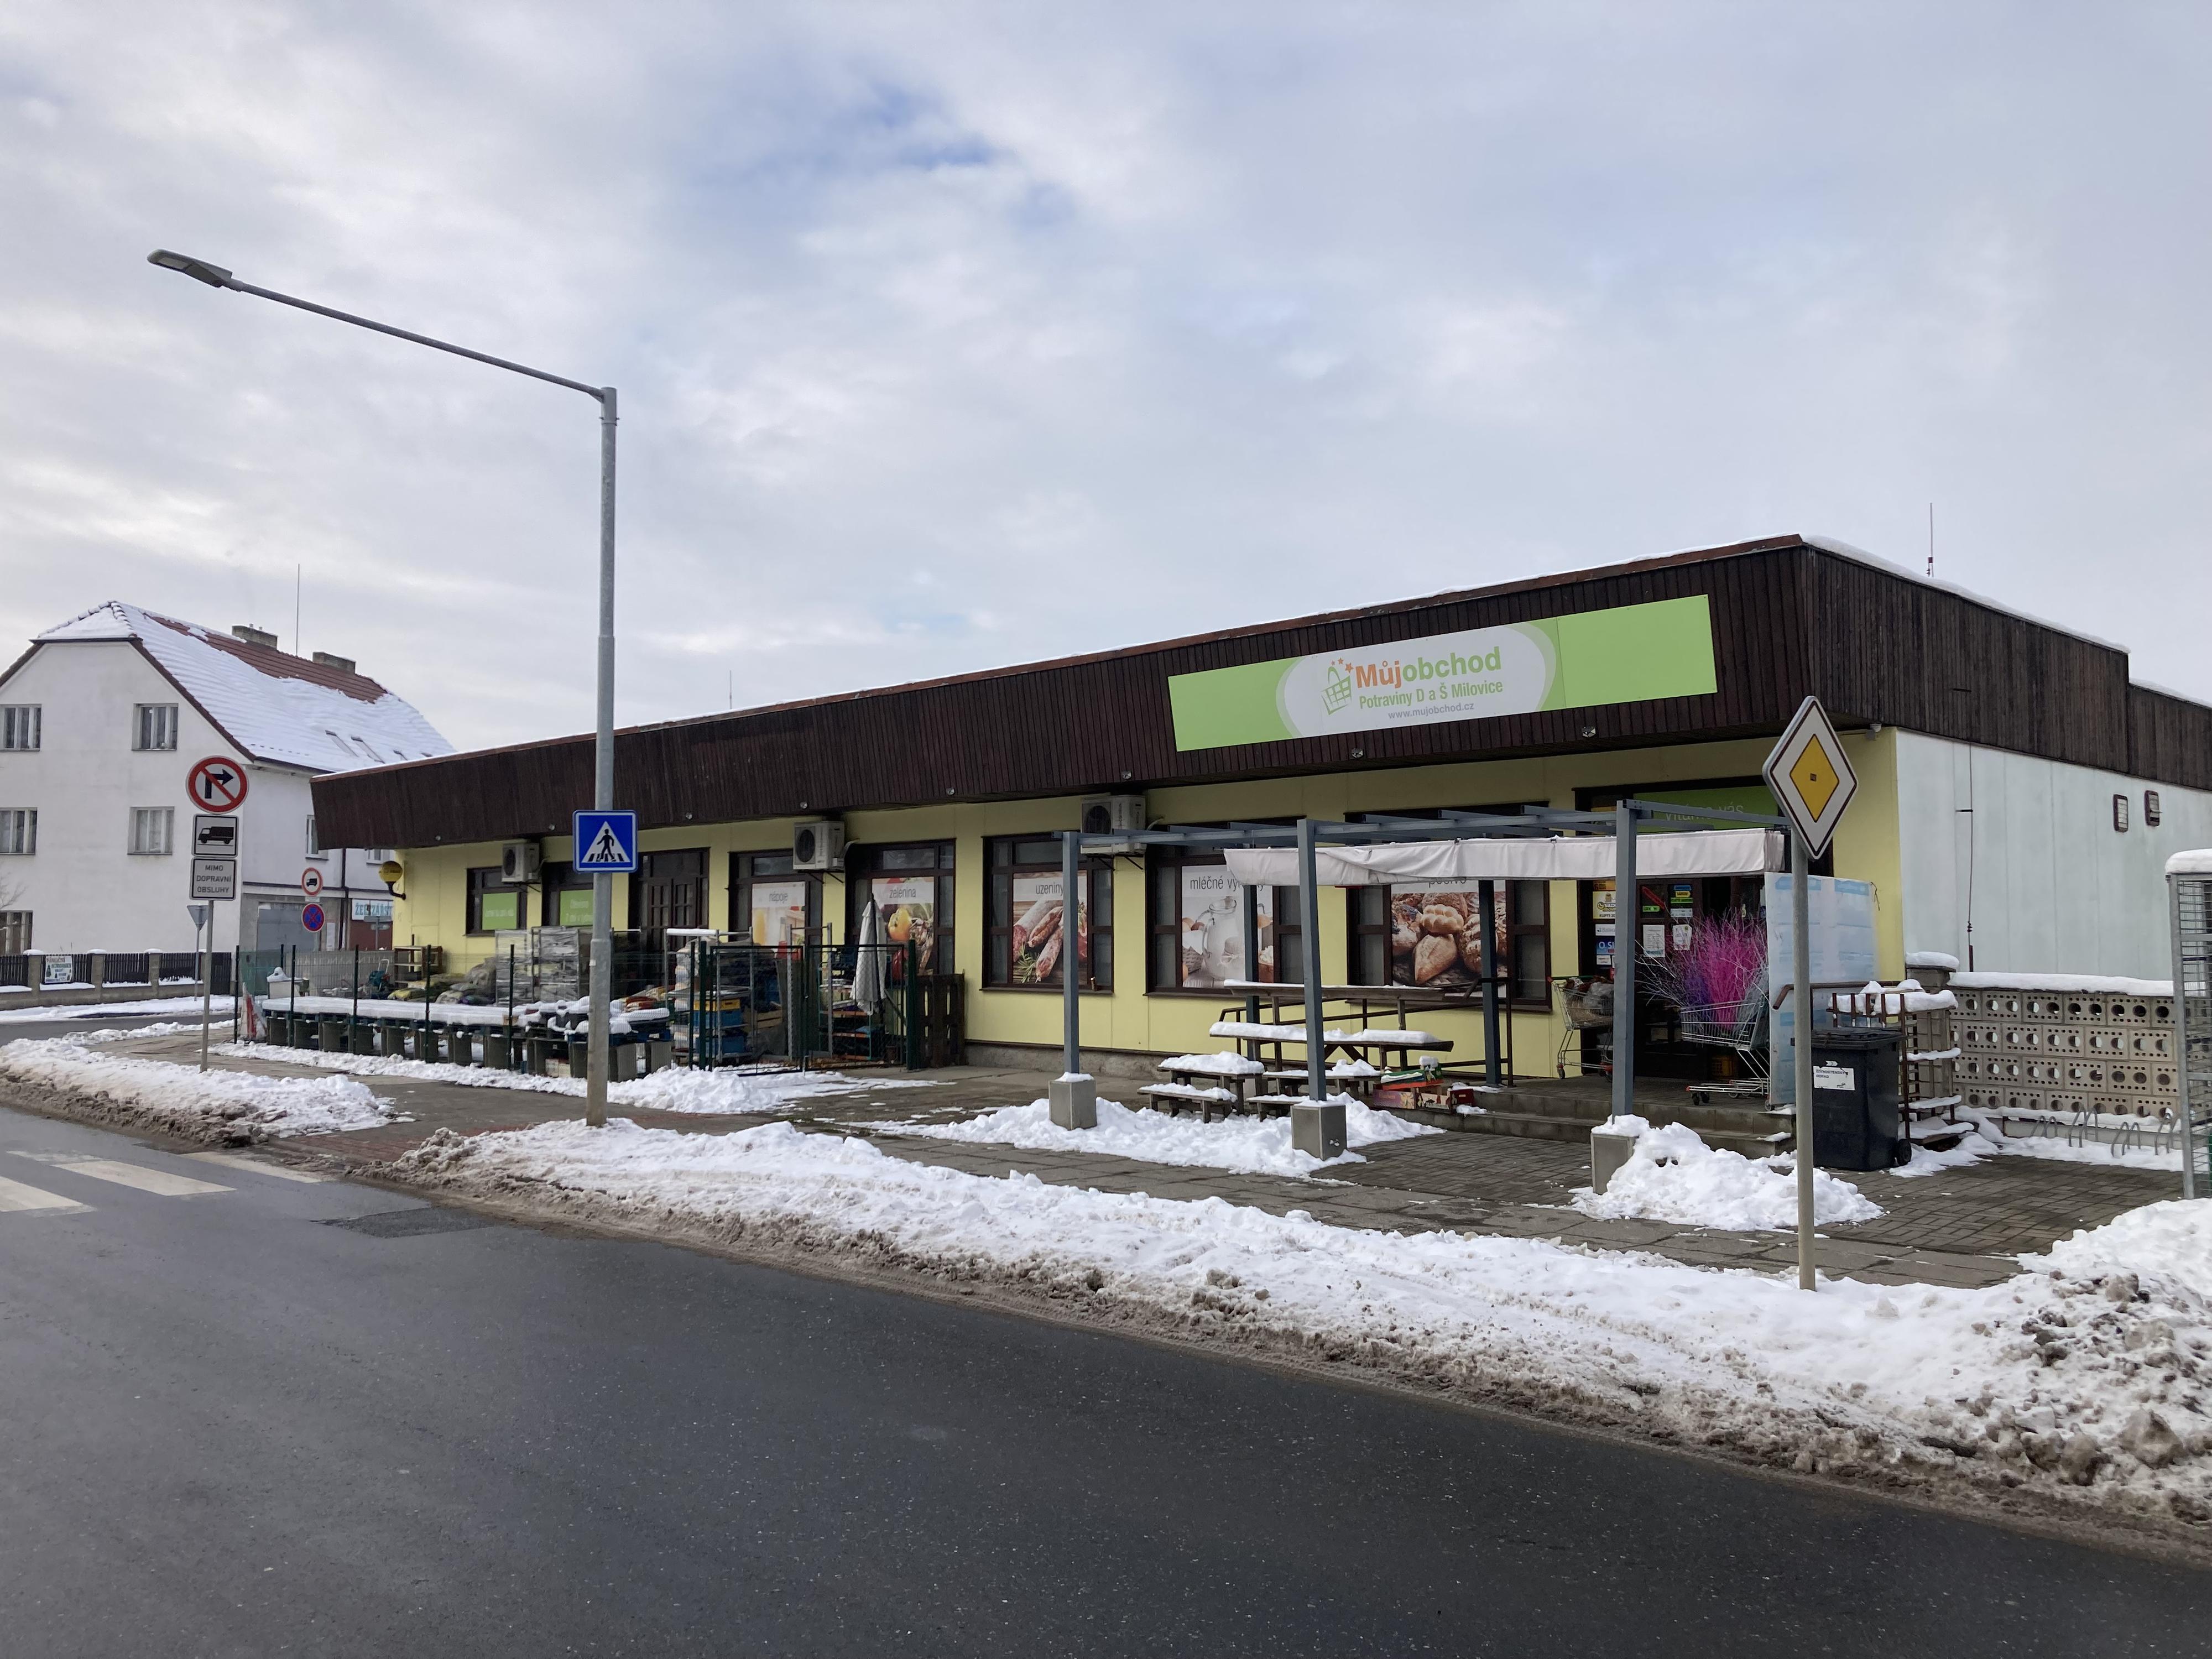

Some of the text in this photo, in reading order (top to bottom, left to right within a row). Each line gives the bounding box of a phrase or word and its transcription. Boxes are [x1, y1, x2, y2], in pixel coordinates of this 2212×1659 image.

[1355, 646, 1501, 688] Můjobchod
[1359, 680, 1503, 709] Potraviny D a Š Milovice
[1388, 702, 1475, 719] www.mujobchod.cz
[1035, 881, 1063, 896] uzeniny
[1190, 875, 1223, 890] mléčné
[889, 887, 916, 898] zelenina
